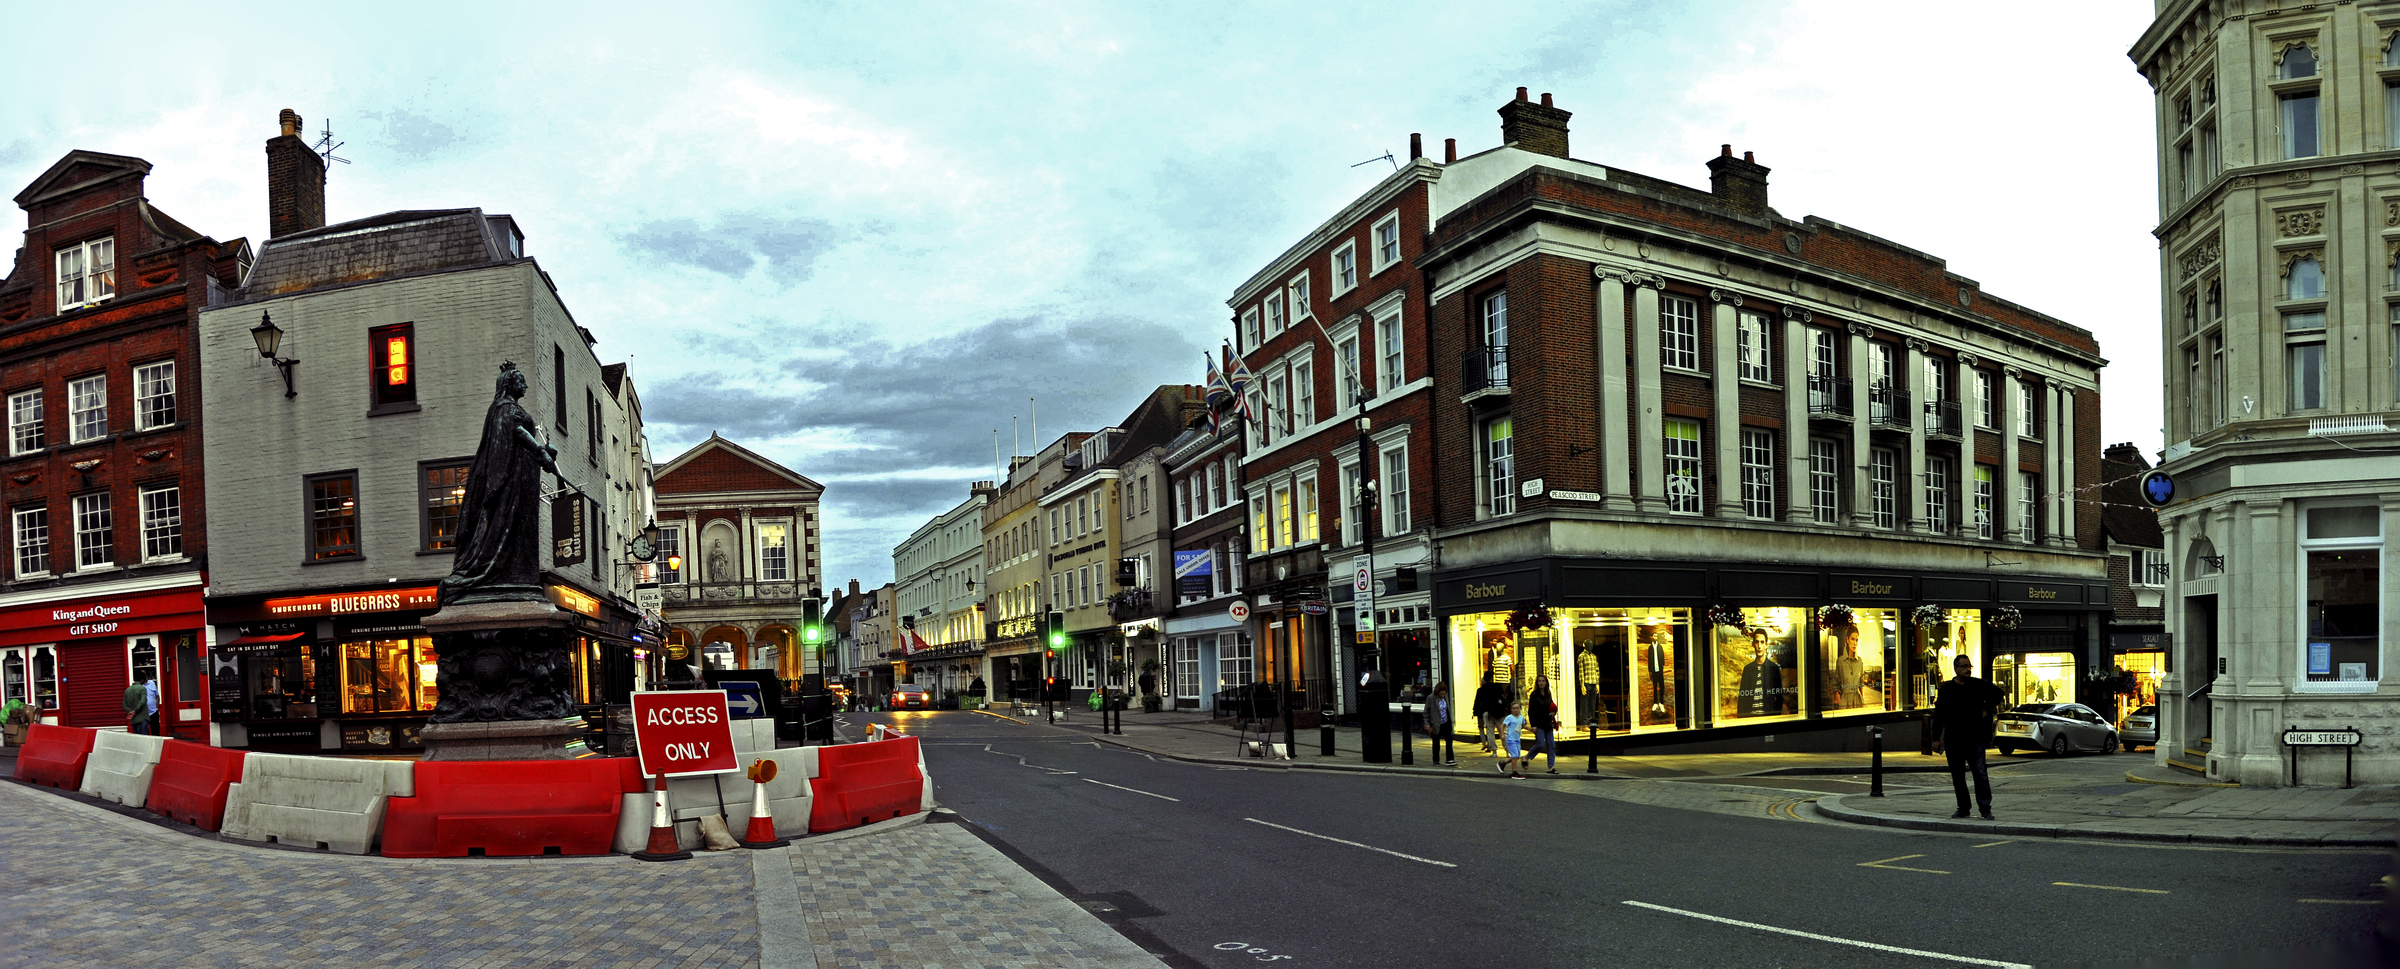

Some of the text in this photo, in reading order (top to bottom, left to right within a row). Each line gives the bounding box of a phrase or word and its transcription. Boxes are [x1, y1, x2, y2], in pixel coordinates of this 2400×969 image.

[1525, 487, 1540, 496] STREET
[1552, 491, 1578, 499] PEASCOD
[573, 499, 582, 557] BLUEGRASS
[1094, 540, 1106, 550] HOTEL
[1186, 560, 1198, 570] UNDER
[1199, 554, 1210, 563] OFFER
[1466, 583, 1506, 599] Barbour
[1851, 580, 1892, 595] Barbour
[2028, 587, 2057, 599] Barbour
[272, 594, 435, 613] SMOKEHOUSE BLUEGRASS B.B.Q.
[53, 605, 130, 621] King and Queen
[70, 622, 118, 636] GIFT SHOP
[259, 622, 296, 631] HATCH
[2142, 634, 2159, 643] SEASALT
[1767, 687, 1798, 695] HERITAGE
[647, 706, 718, 726] ACCESS
[2289, 733, 2353, 743] HIGH STREET
[665, 742, 710, 761] ONLY
